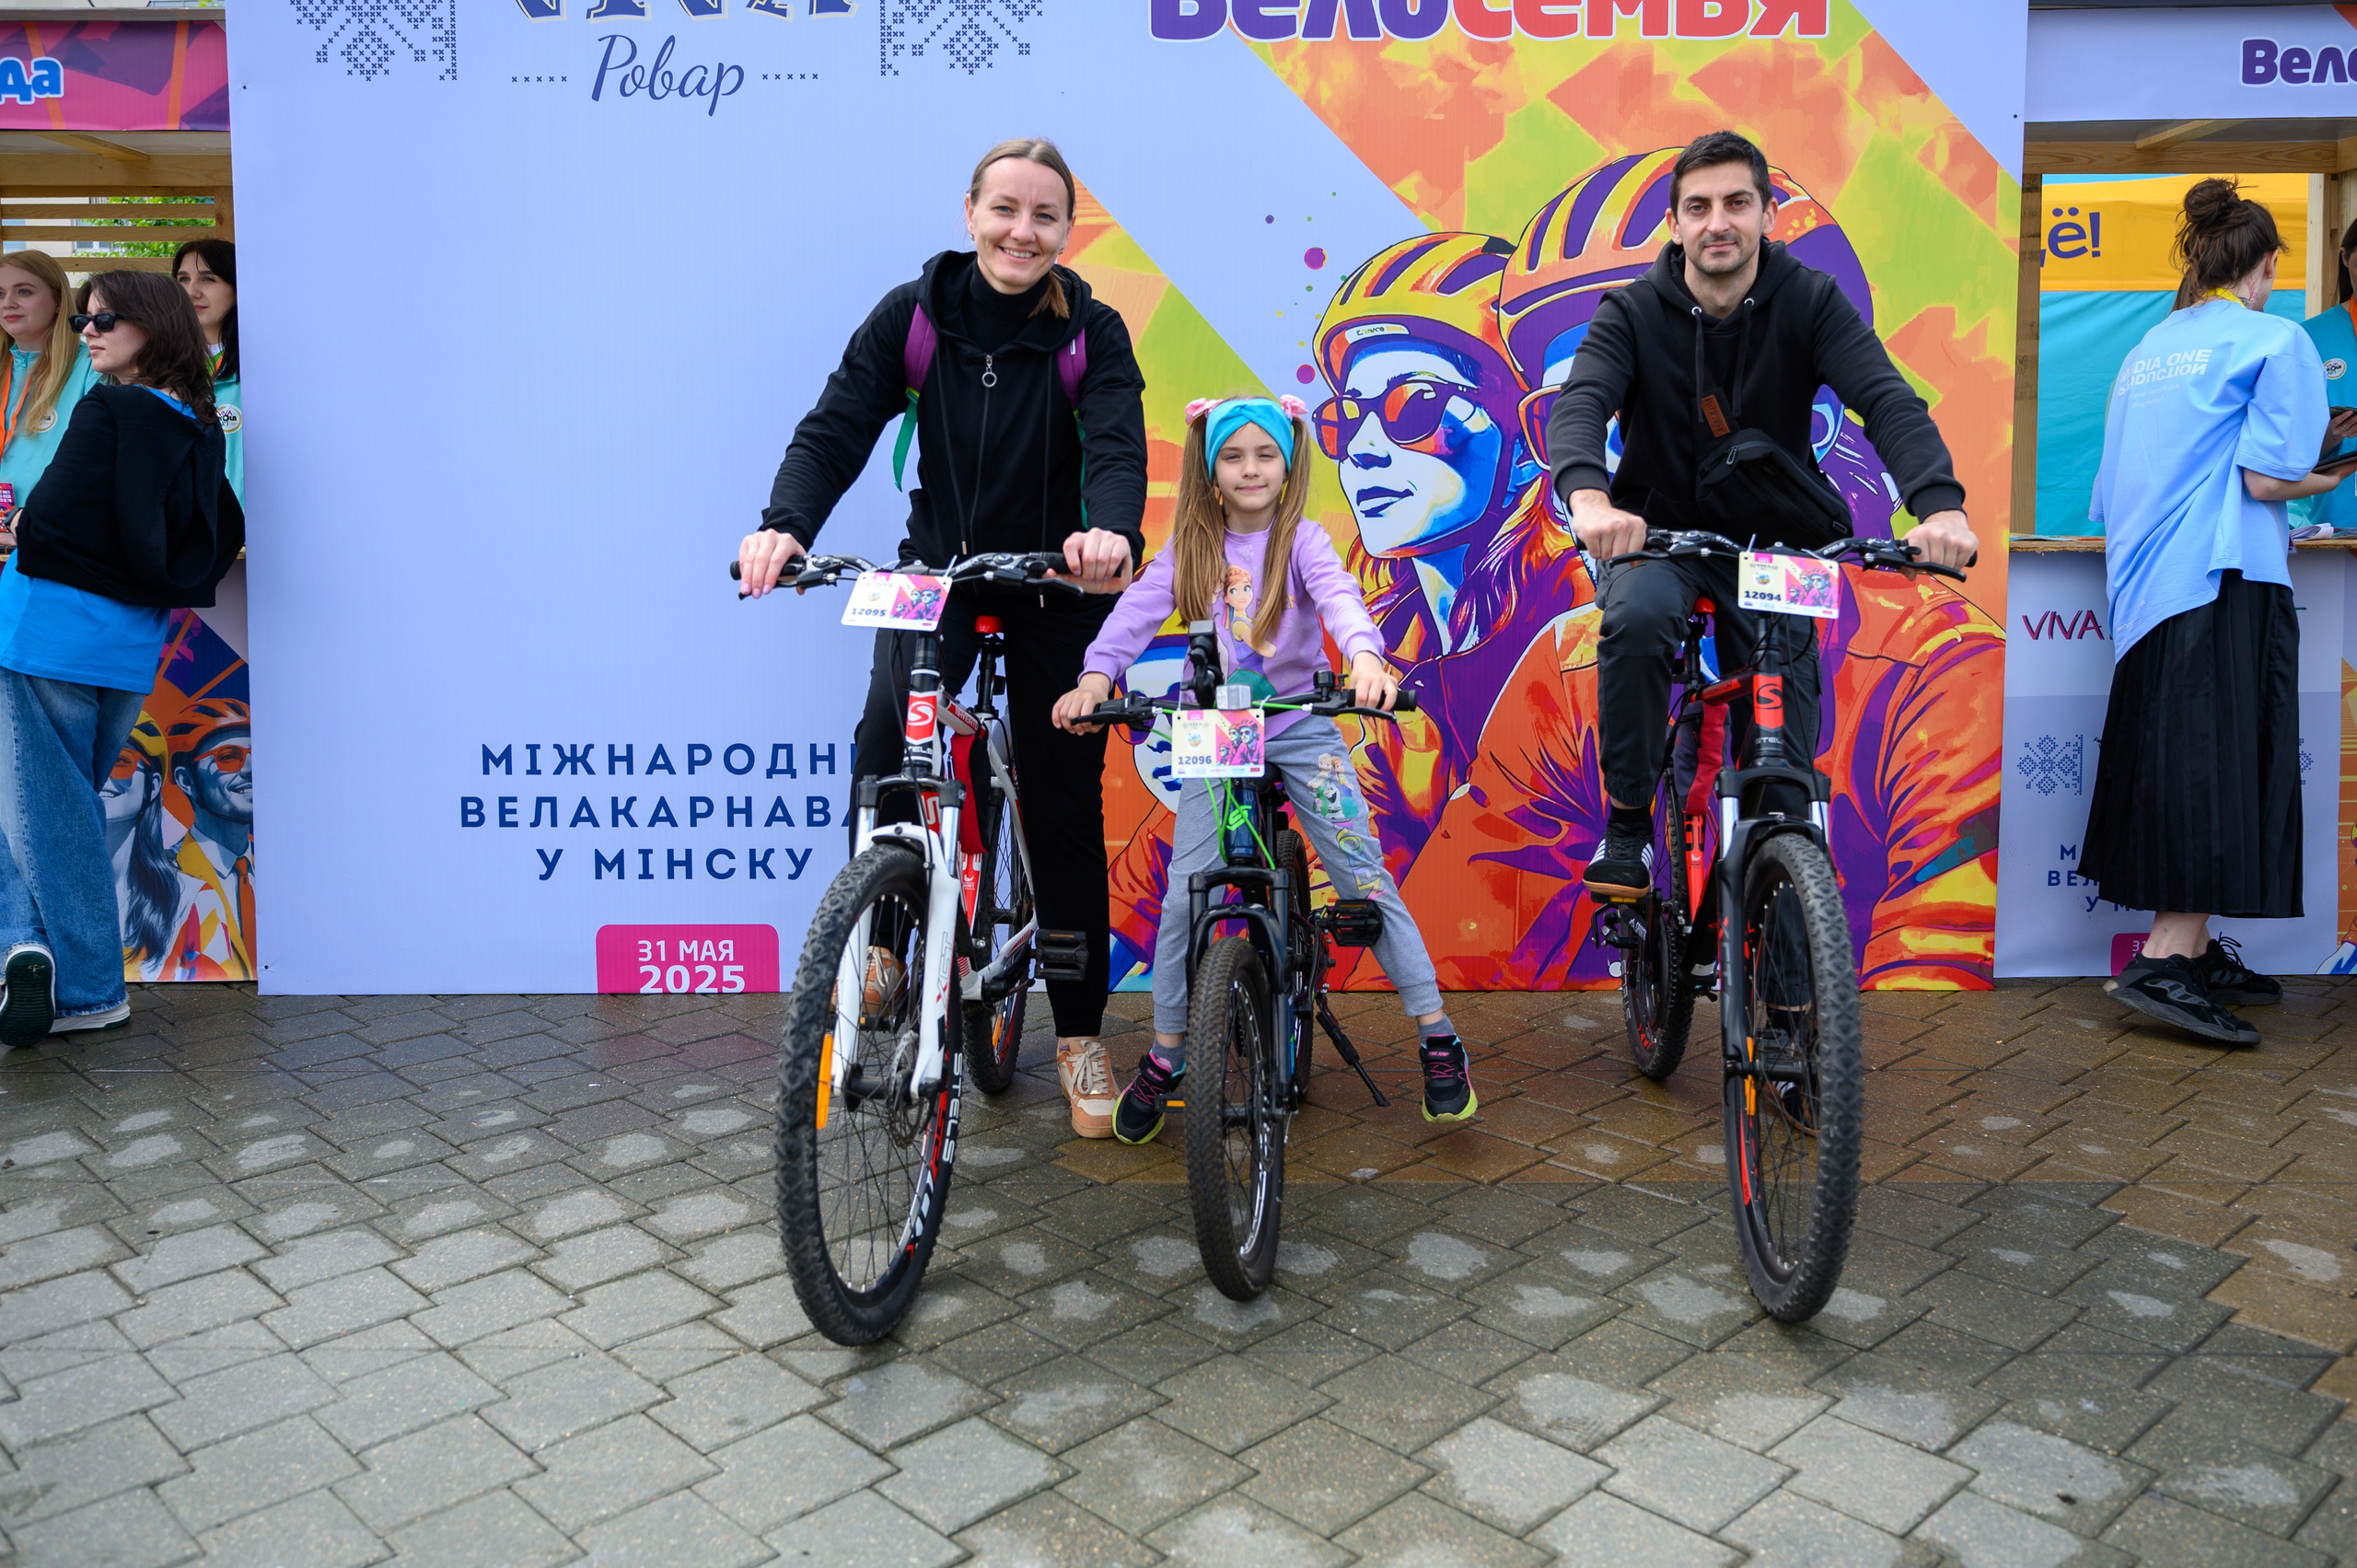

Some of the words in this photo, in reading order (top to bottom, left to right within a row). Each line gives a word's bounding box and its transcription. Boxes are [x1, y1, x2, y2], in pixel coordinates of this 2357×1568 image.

[2166, 349, 2212, 366] ONE
[1744, 590, 1782, 601] 12094
[851, 608, 887, 617] 12095
[2021, 610, 2106, 640] VIVA
[482, 743, 856, 779] МІЖНАРОДН
[1178, 755, 1213, 765] 12096
[535, 848, 564, 881] У
[594, 847, 814, 881] МІНСКУ
[638, 940, 666, 962] 31
[679, 939, 735, 962] МАЯ
[639, 965, 746, 993] 2025
[942, 1051, 963, 1164] STELS
